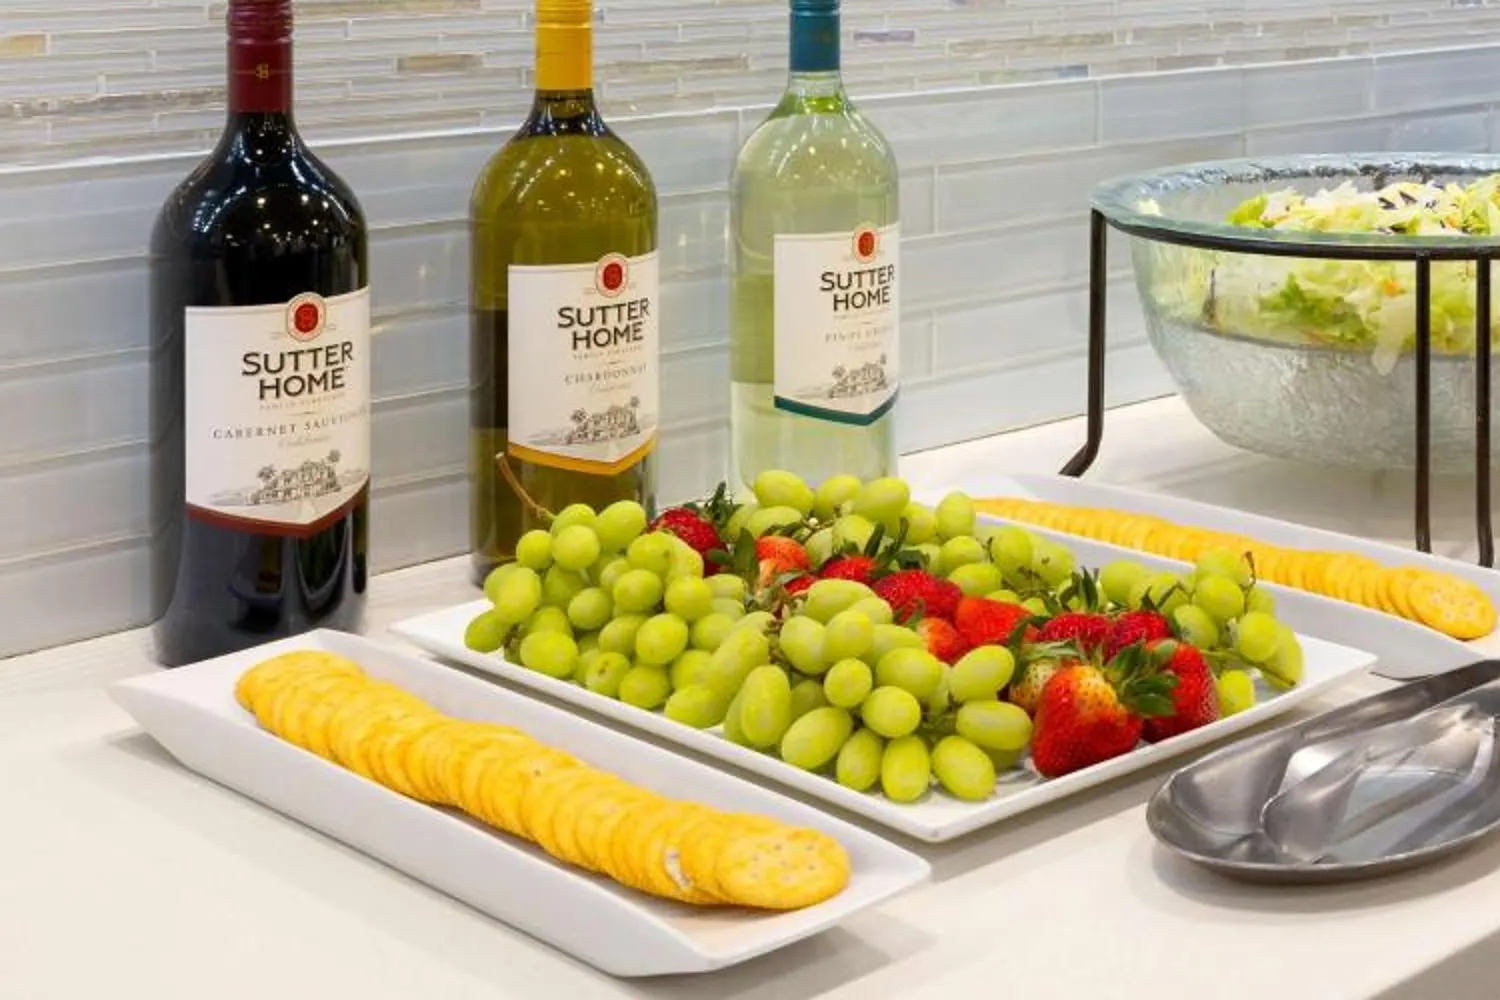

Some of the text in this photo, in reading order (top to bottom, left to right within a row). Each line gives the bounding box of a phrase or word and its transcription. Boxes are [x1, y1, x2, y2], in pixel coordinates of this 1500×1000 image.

[820, 264, 894, 292] SUTTER
[557, 298, 650, 328] SUTTER
[833, 285, 890, 312] HOME
[573, 321, 643, 351] HOME
[242, 341, 354, 376] SUTTER
[259, 367, 345, 400] HOME
[213, 405, 368, 440] CABERNET SAUVI
